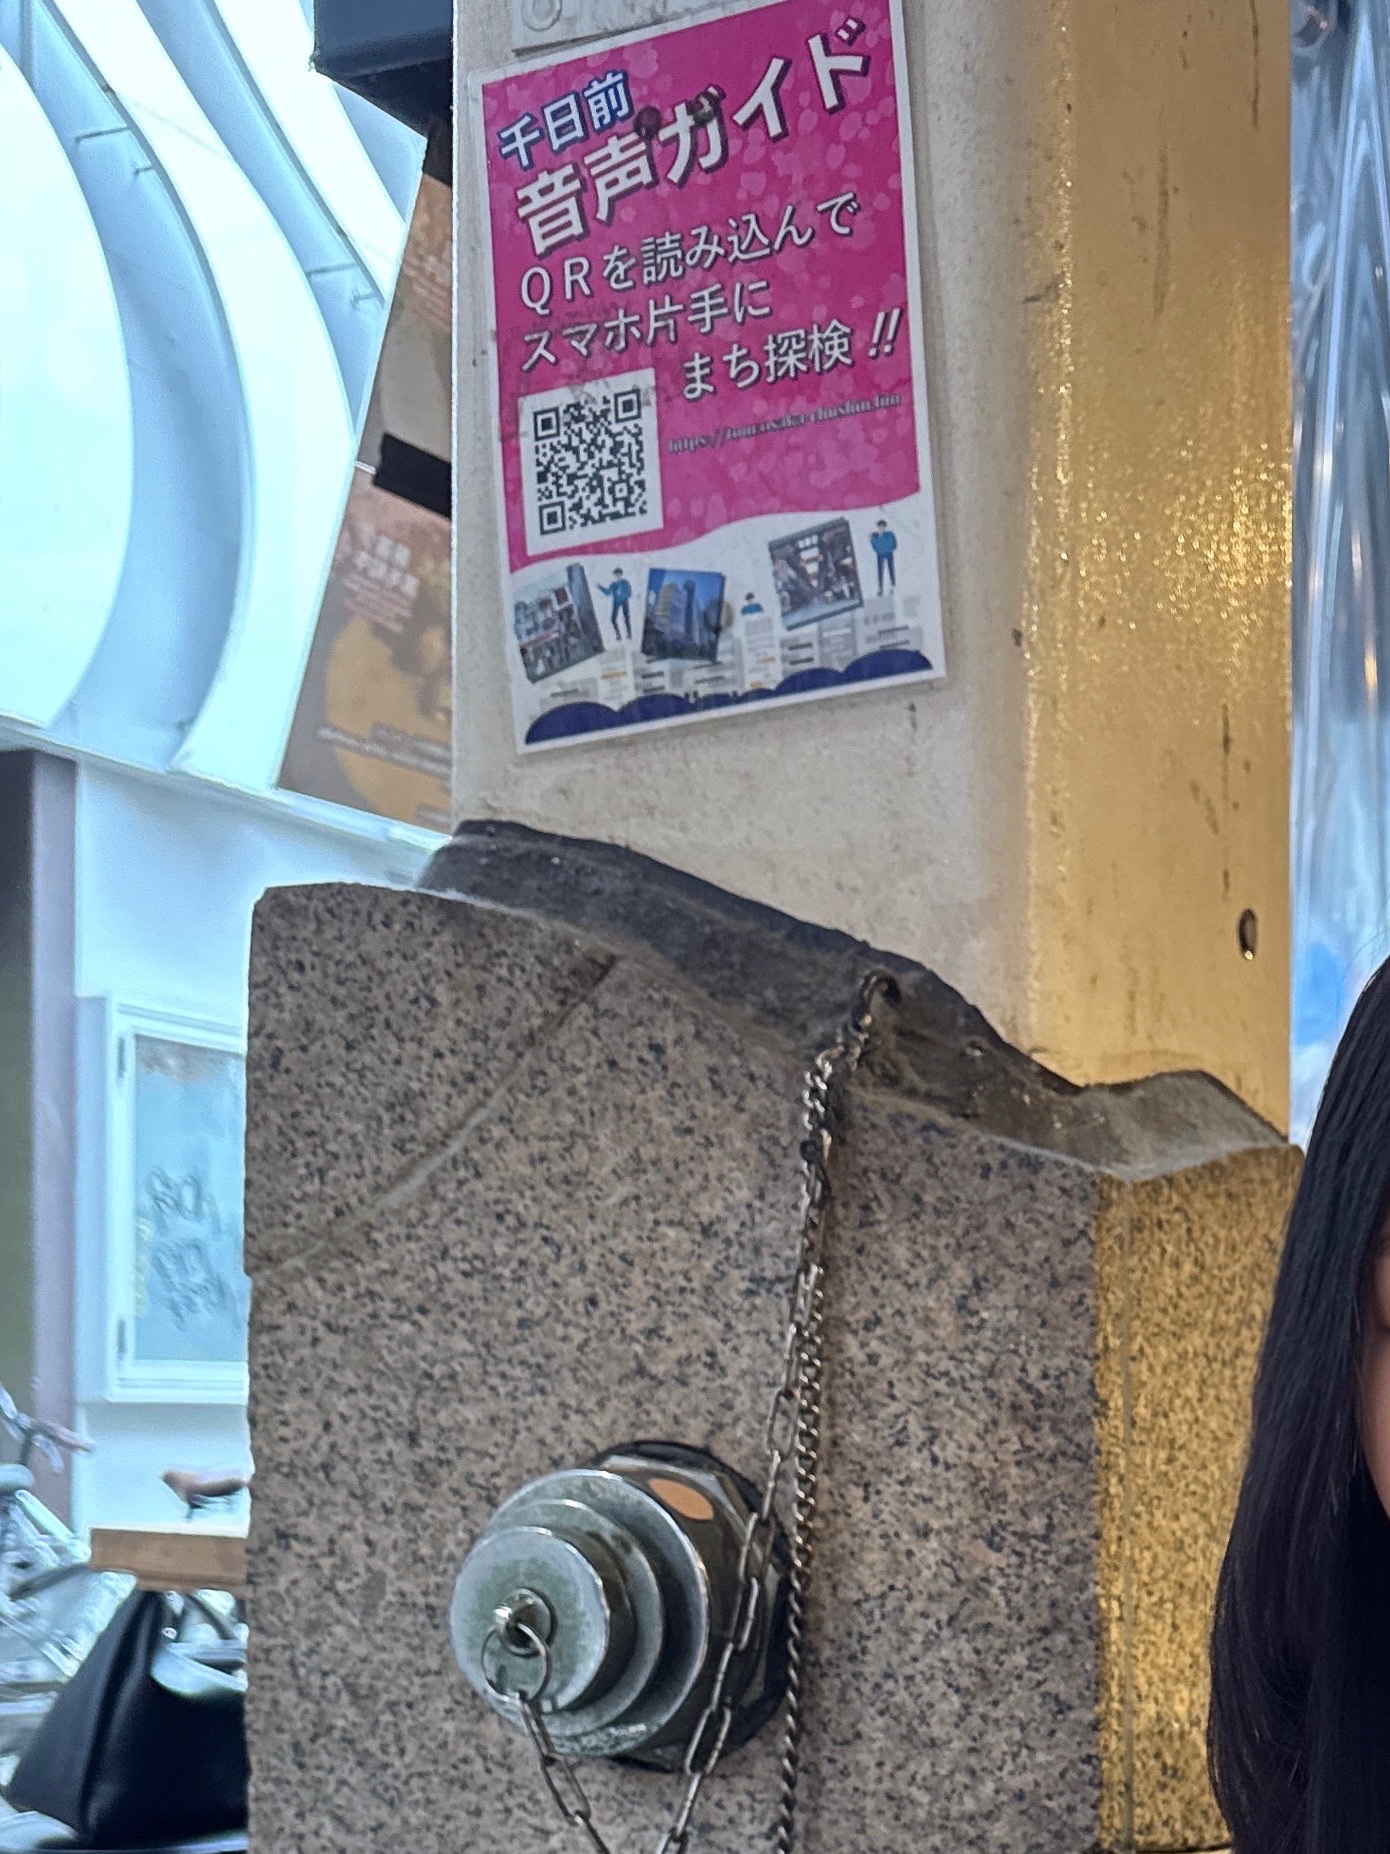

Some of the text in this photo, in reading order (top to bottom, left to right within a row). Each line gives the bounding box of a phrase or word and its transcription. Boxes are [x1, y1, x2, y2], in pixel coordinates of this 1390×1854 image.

[500, 72, 632, 169] 千日前
[517, 18, 867, 255] 音声ガイド
[521, 192, 860, 316] QRを読み込んで
[522, 280, 771, 371] スマホ片手に
